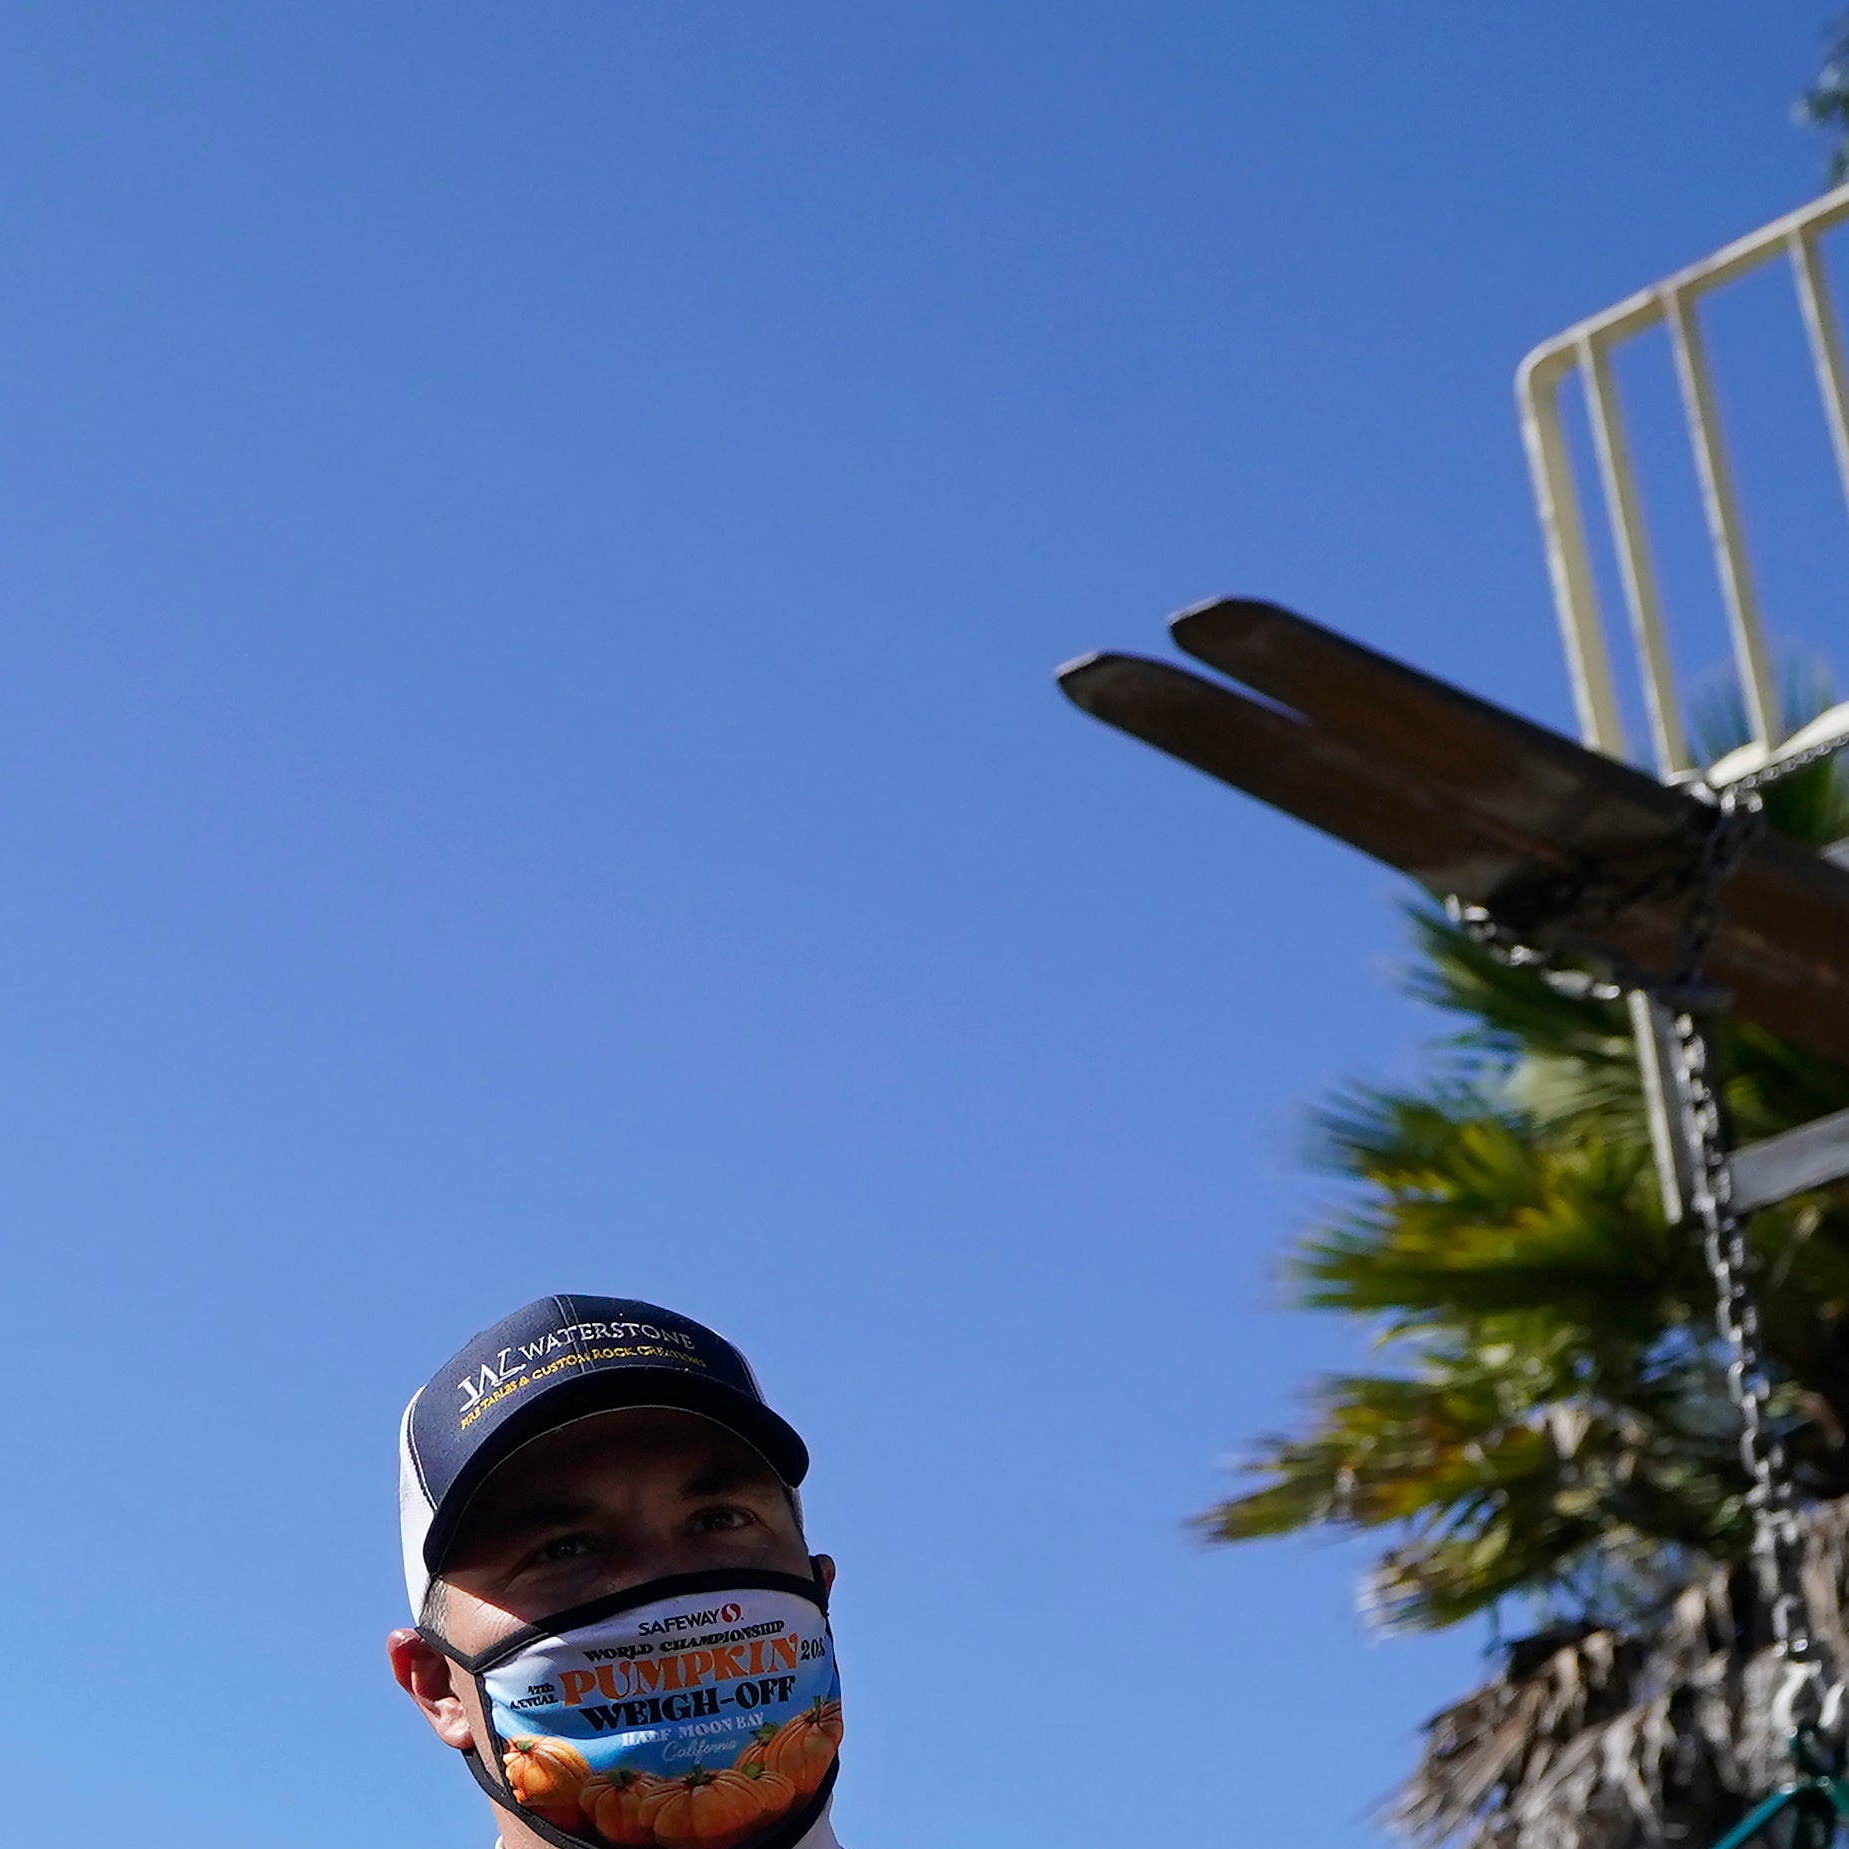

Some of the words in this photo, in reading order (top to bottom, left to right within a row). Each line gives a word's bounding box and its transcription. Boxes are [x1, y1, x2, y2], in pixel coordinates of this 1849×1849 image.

[518, 1322, 695, 1360] WATERSTONE
[480, 1381, 518, 1410] TABLES
[532, 1353, 591, 1380] CUSTOM
[591, 1347, 639, 1360] ROCK
[582, 1643, 654, 1662] WORLD
[659, 1620, 784, 1652] CHAMPIONSHIP
[638, 1608, 720, 1636] SAFEWAY
[558, 1633, 798, 1706] PUMPKIN
[579, 1674, 796, 1732] WEIGH-OFF
[621, 1729, 672, 1747] HALF
[678, 1718, 733, 1739] MOON
[735, 1711, 764, 1730] BAY
[663, 1739, 740, 1764] California
